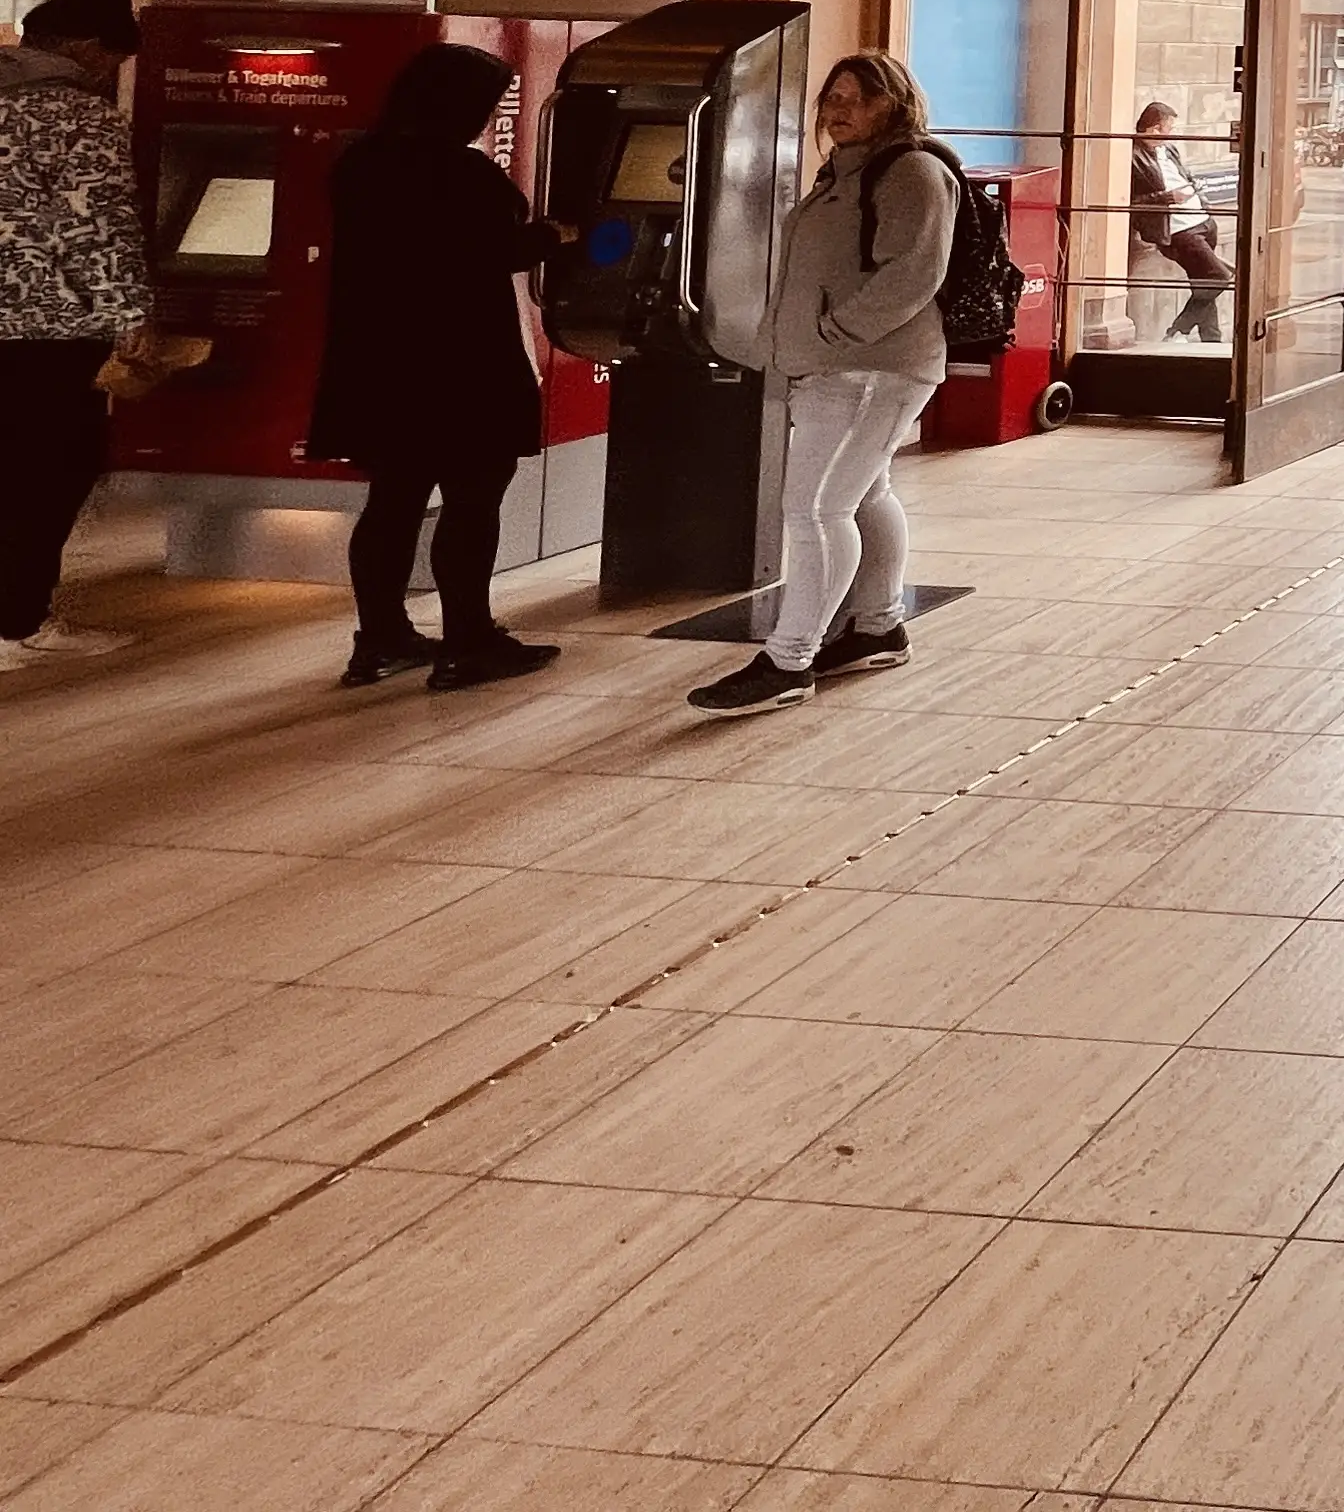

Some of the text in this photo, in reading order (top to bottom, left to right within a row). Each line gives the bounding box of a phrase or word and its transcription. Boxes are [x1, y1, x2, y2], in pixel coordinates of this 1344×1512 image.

[232, 89, 268, 104] Train
[271, 90, 349, 107] departures
[494, 74, 521, 178] illette
